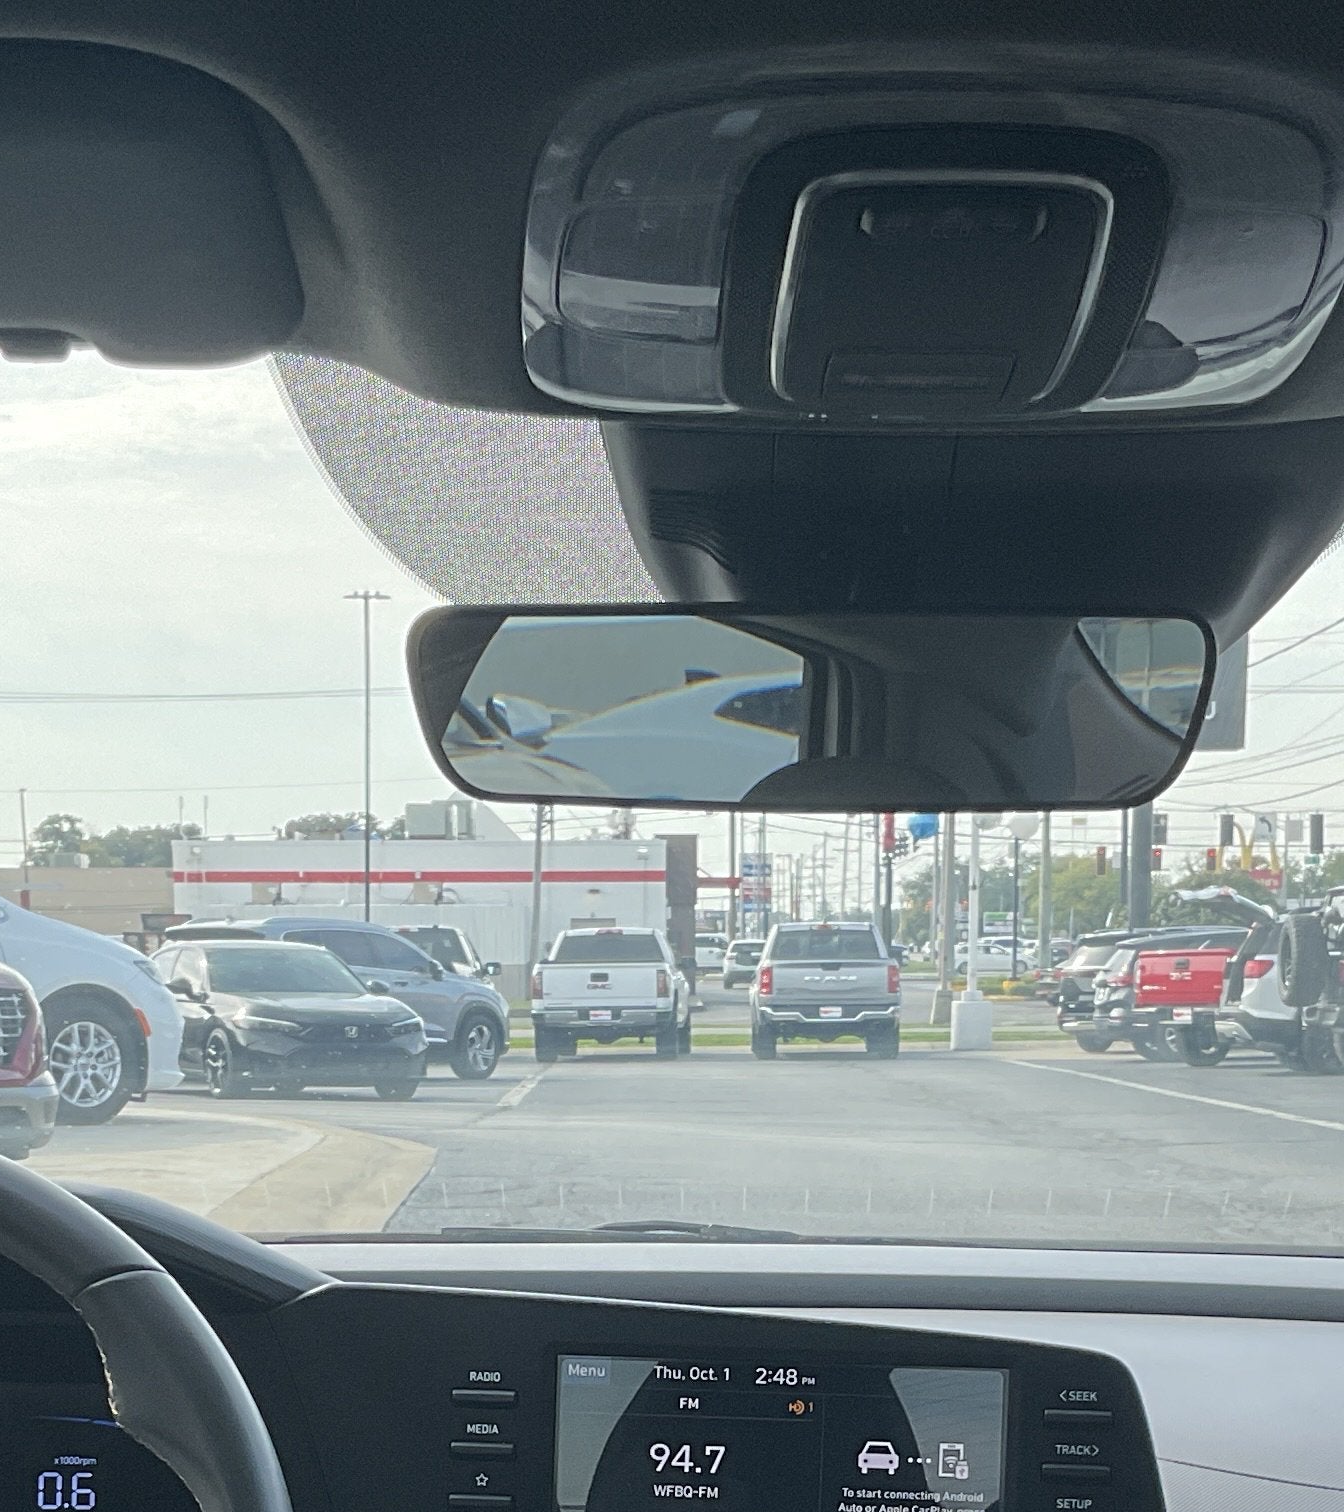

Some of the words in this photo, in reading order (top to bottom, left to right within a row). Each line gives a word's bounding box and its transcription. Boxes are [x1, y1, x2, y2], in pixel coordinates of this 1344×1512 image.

[586, 982, 612, 991] GMC
[469, 1371, 501, 1382] RADIO
[568, 1363, 606, 1379] Menu
[654, 1365, 686, 1381] Thu,
[689, 1366, 718, 1382] Oct.
[724, 1367, 731, 1381] 1
[755, 1367, 798, 1386] 2:48
[801, 1377, 816, 1386] PM
[1068, 1390, 1098, 1402] SEEK
[679, 1397, 699, 1410] FM
[466, 1423, 499, 1434] MEDIA
[1055, 1444, 1092, 1455] TRACK
[54, 1456, 97, 1467] x1000rpm
[649, 1443, 726, 1474] 94.7
[37, 1471, 96, 1511] 0.6
[653, 1484, 719, 1499] WFBQ-FM
[841, 1487, 855, 1498] To
[856, 1489, 882, 1499] start
[883, 1490, 941, 1503] connecting
[942, 1491, 984, 1502] Android
[837, 1502, 863, 1512] Auto
[864, 1504, 877, 1512] or
[1056, 1498, 1092, 1509] SETUP
